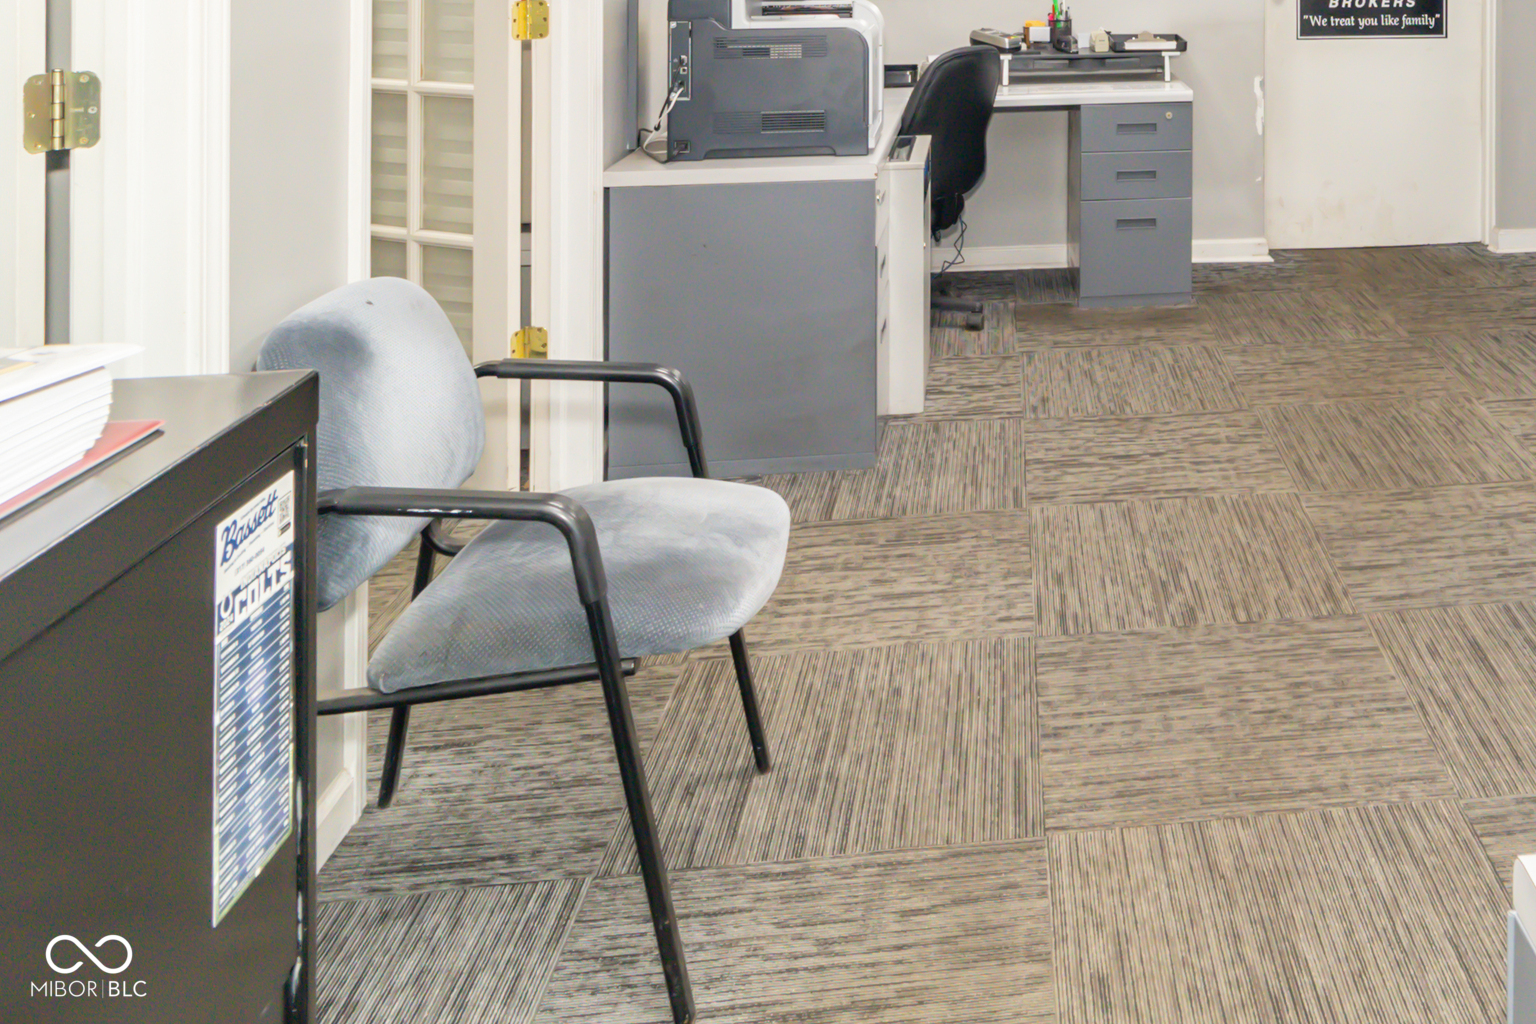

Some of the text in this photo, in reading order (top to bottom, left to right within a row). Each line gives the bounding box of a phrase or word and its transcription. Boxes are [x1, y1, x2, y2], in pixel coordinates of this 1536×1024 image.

[1303, 14, 1441, 30] "We treat you like family"
[220, 488, 279, 567] Bassett
[234, 550, 293, 626] COLTS
